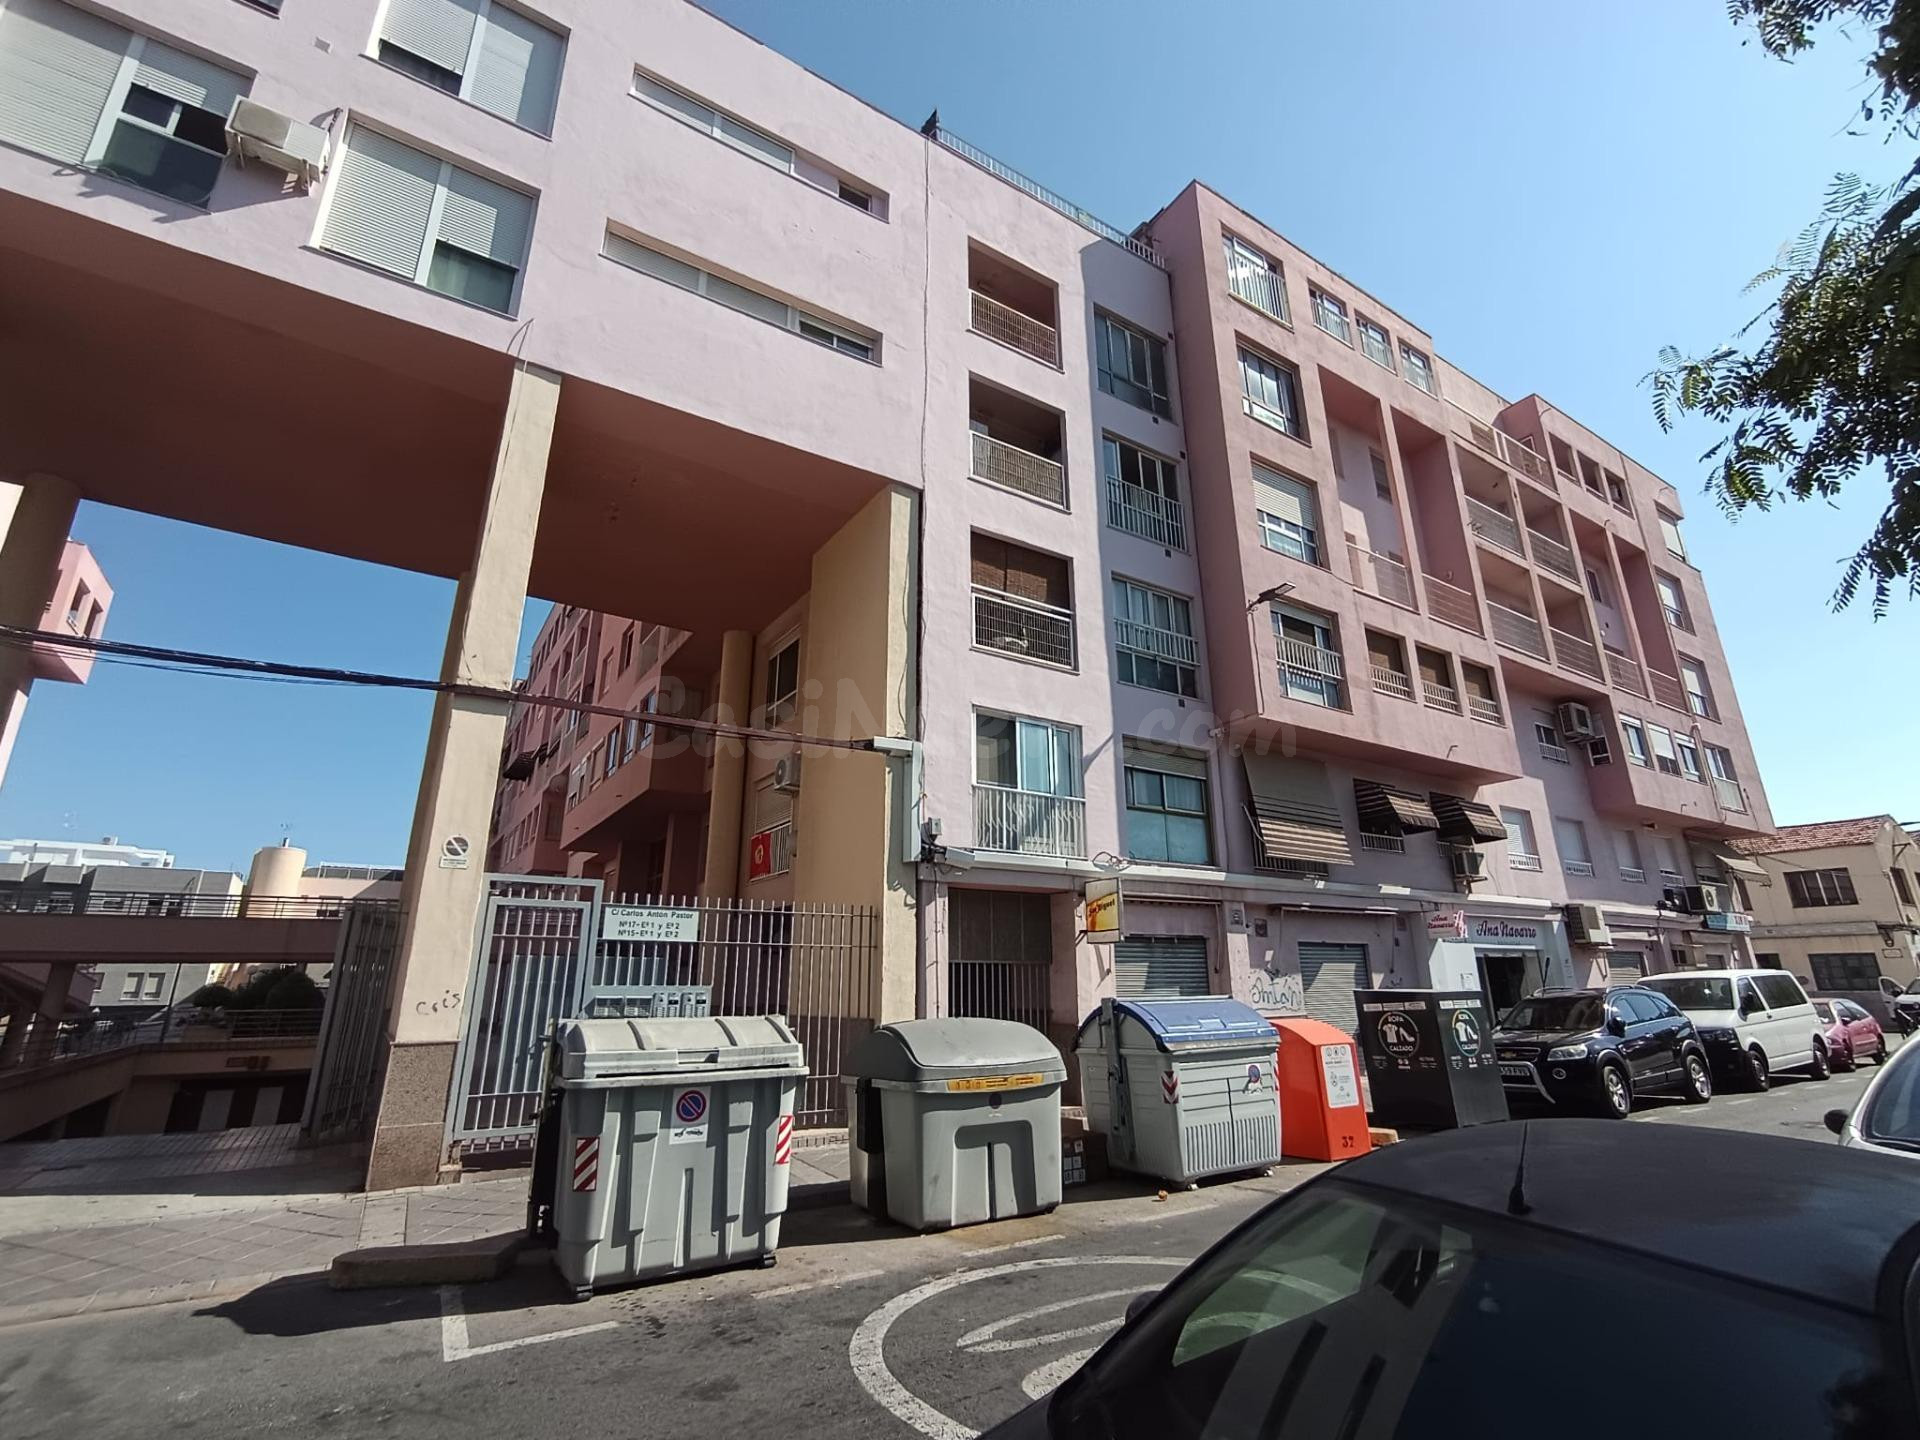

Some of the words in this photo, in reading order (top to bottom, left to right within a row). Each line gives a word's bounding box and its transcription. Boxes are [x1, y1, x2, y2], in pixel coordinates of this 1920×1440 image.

[621, 909, 644, 917] Carlos
[671, 911, 694, 919] Pastor
[1476, 920, 1499, 936] Ana
[1500, 921, 1537, 938] Navarro
